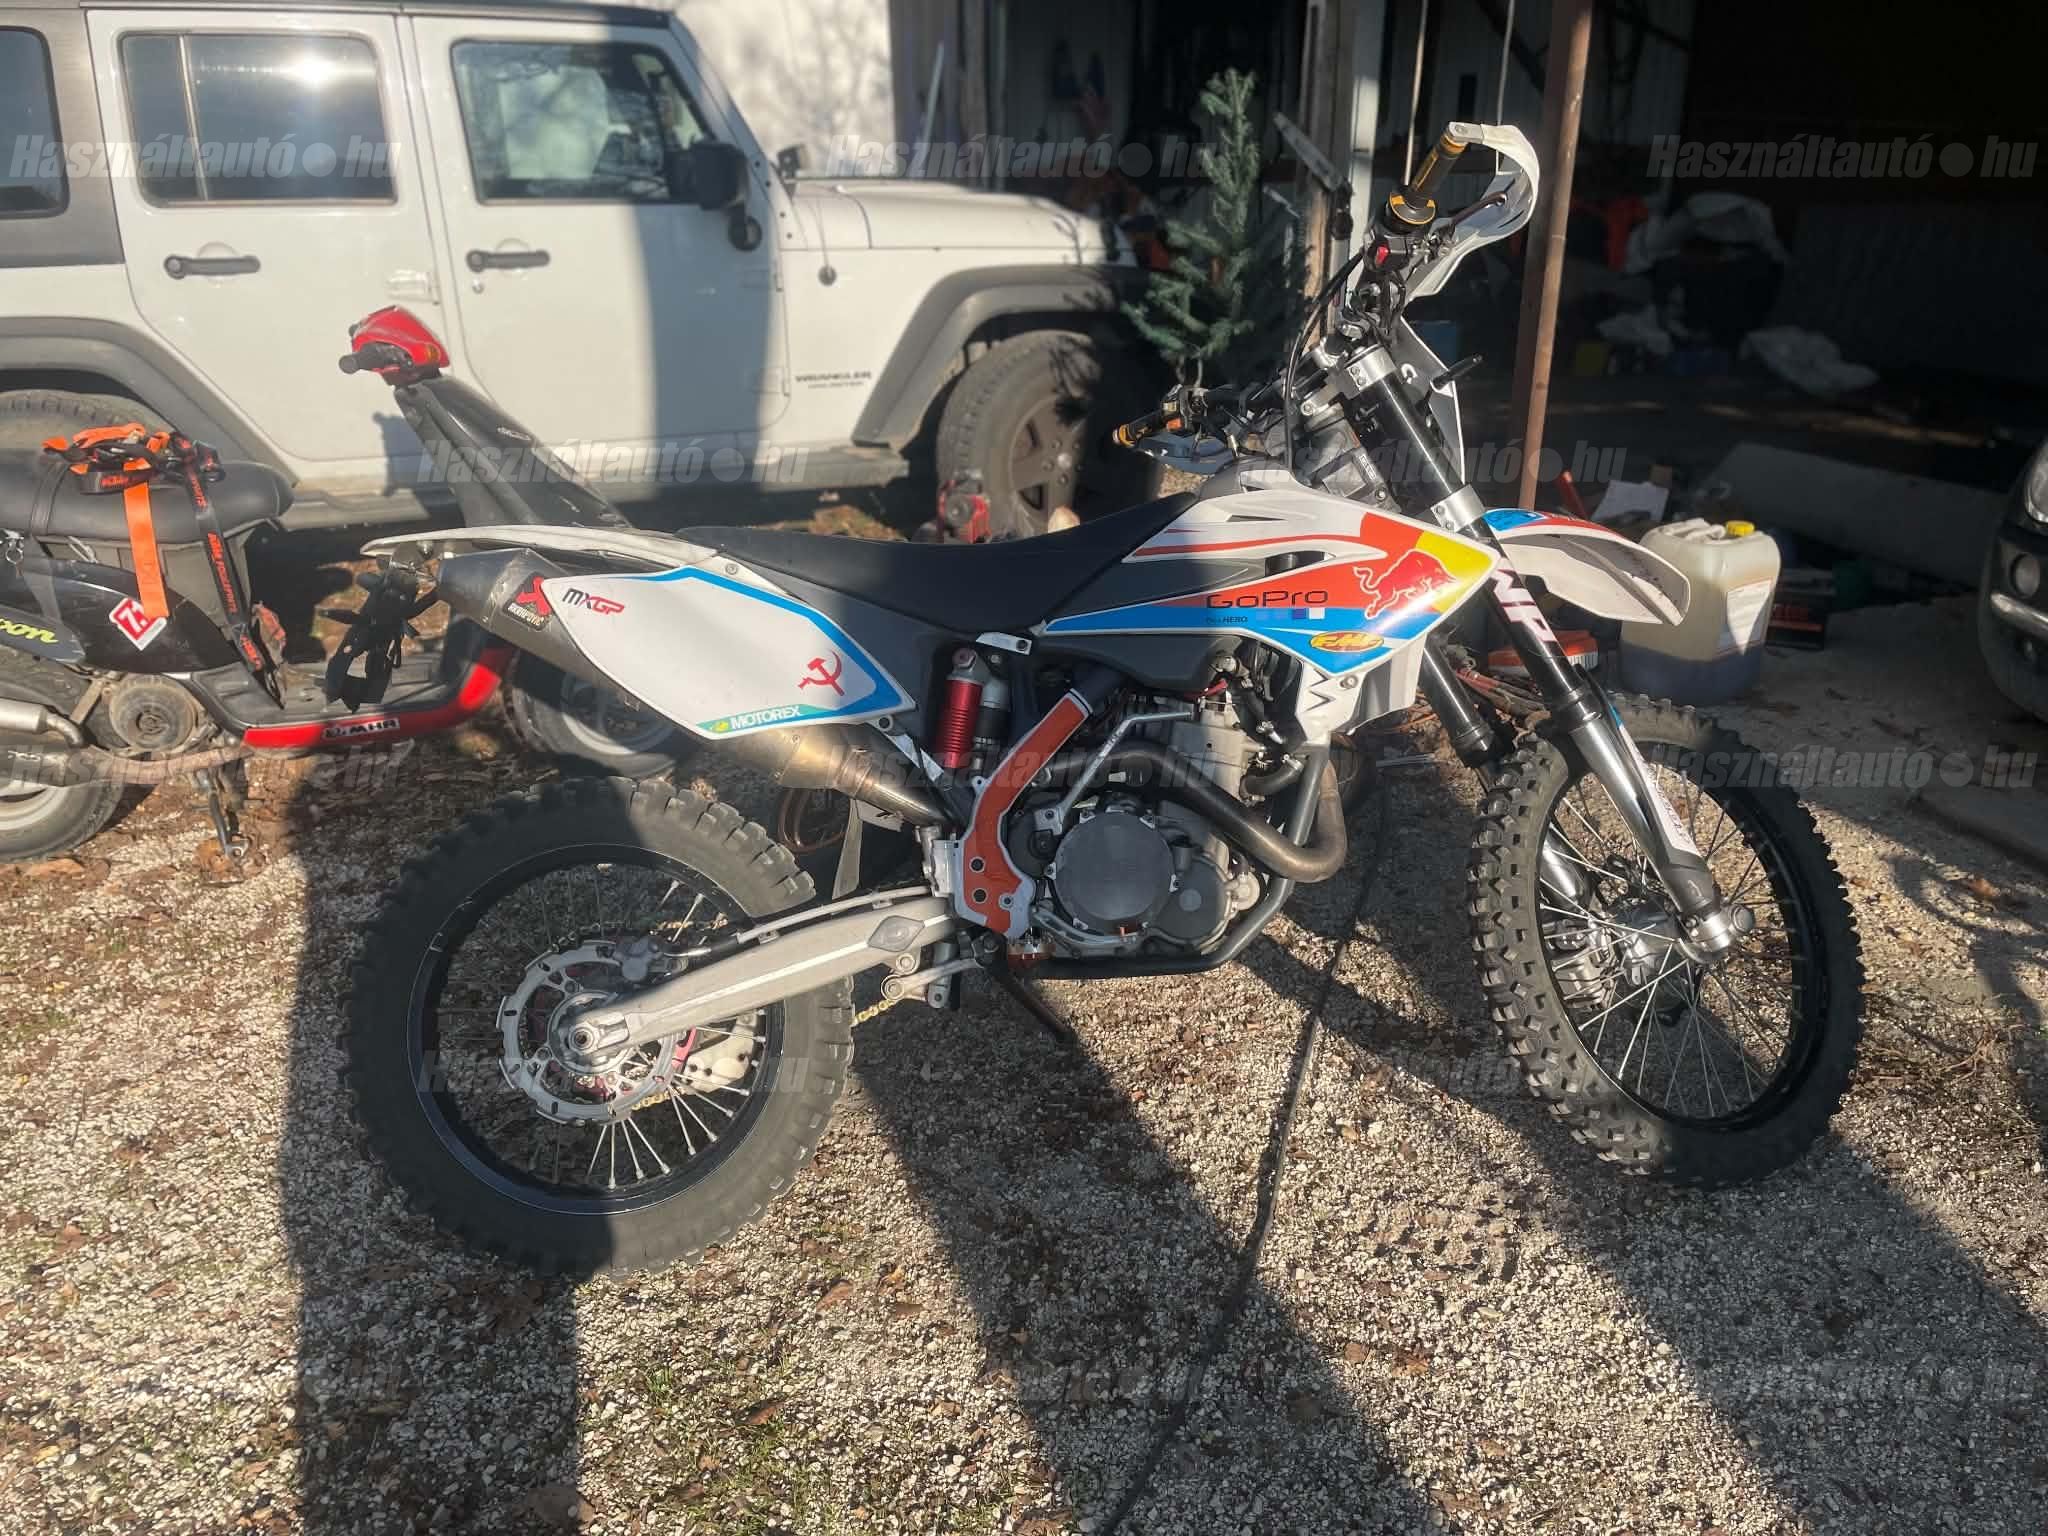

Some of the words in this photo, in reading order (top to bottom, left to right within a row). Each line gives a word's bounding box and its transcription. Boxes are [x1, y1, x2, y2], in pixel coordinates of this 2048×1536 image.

[562, 587, 625, 615] MXGP
[1206, 590, 1328, 609] GoPro
[730, 704, 802, 729] MOTOREX
